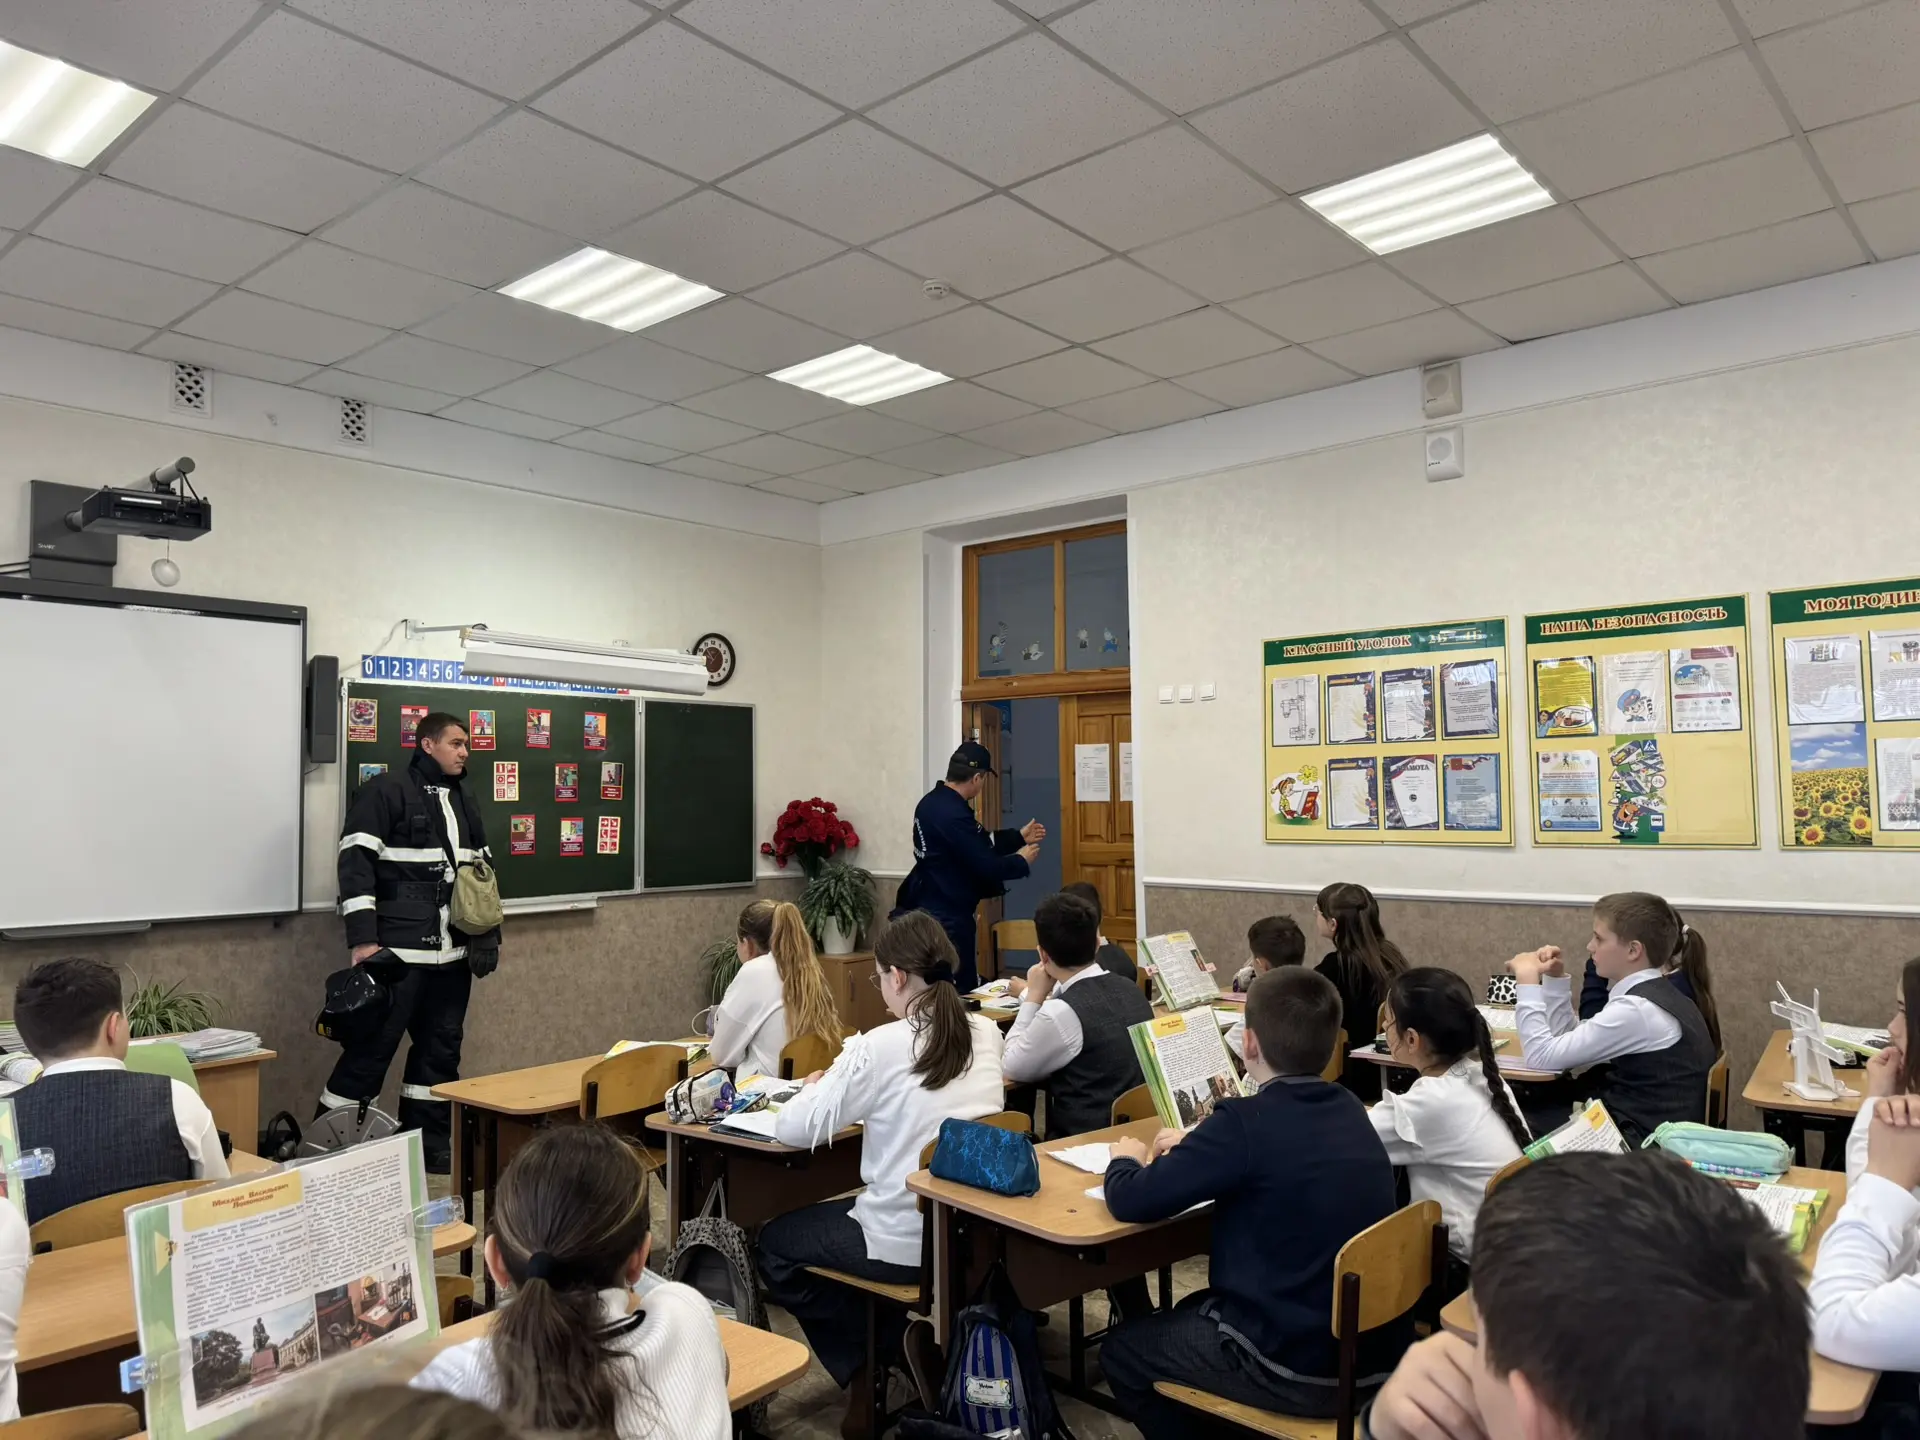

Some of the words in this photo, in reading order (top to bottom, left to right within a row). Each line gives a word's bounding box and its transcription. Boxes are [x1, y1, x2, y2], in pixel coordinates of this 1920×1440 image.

[1804, 596, 1850, 614] МОЯ
[1541, 619, 1591, 635] НАША
[1592, 606, 1728, 630] БЕЗОПАСНОСТЬ
[1284, 638, 1355, 657] КЛАССНЫЙ
[1357, 635, 1411, 650] УГОЛОК
[365, 659, 373, 675] 0
[379, 660, 385, 676] 1
[392, 661, 400, 677] 2
[405, 661, 413, 677] 3
[418, 663, 427, 678] 4
[432, 663, 440, 679] 5
[445, 664, 453, 680] 6
